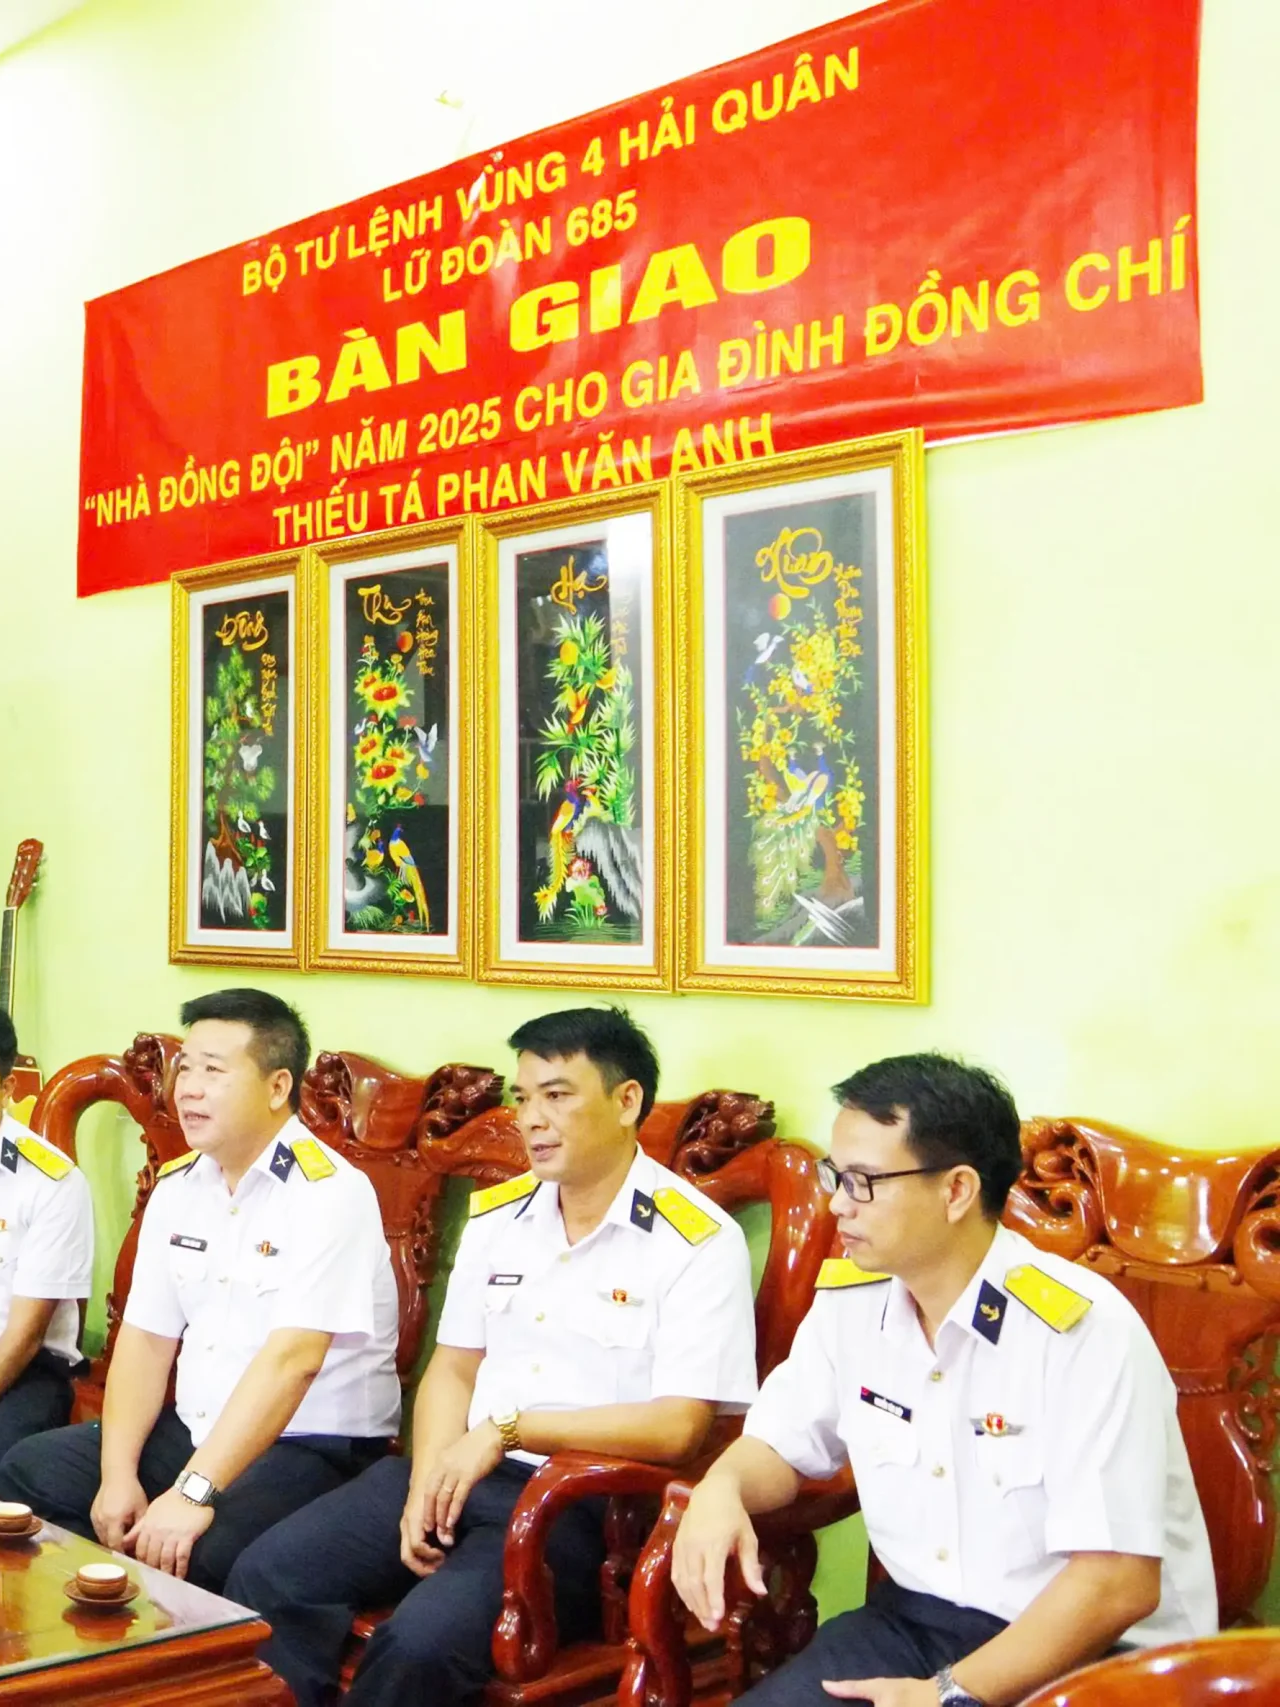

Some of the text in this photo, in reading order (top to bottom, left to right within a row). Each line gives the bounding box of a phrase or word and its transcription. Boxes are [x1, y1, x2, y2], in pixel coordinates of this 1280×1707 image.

[242, 246, 287, 296] BỘ
[294, 231, 340, 276] TƯ
[346, 195, 442, 260] LỆNH
[580, 136, 605, 177] 4
[619, 96, 696, 167] HẢI
[711, 47, 860, 134] QUÂN
[383, 189, 637, 303] LỮ ĐOÀN 685
[159, 454, 240, 513] ĐỒNG
[330, 418, 408, 474] NĂM
[417, 396, 502, 455] 2025
[514, 371, 609, 432] CHO
[620, 350, 701, 410] GIA
[718, 315, 845, 388] ĐÌNH
[863, 268, 1041, 358] ĐỒNG
[1064, 214, 1192, 313] CHÍ
[266, 216, 811, 419] BÀN GIAO
[272, 412, 776, 546] THIẾU TÁ PHAN VĂN ANH
